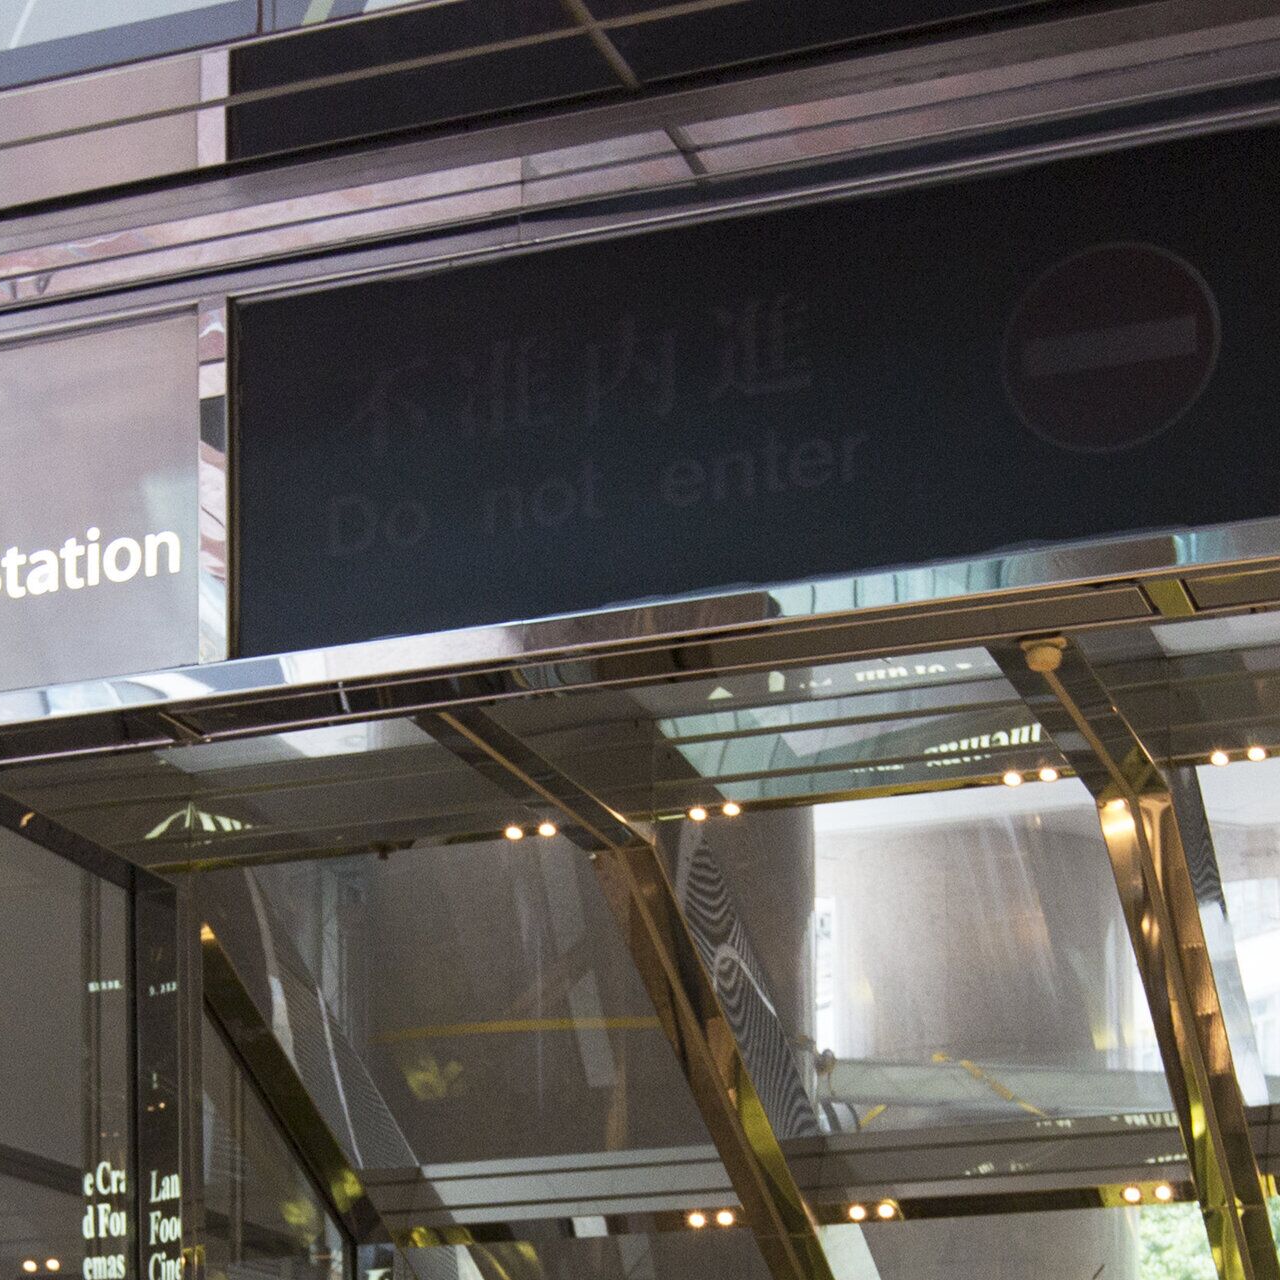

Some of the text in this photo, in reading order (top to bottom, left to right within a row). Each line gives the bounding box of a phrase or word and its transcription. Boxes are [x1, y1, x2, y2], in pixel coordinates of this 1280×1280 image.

[327, 426, 871, 557] Do not enter
[83, 1254, 126, 1280] emas
